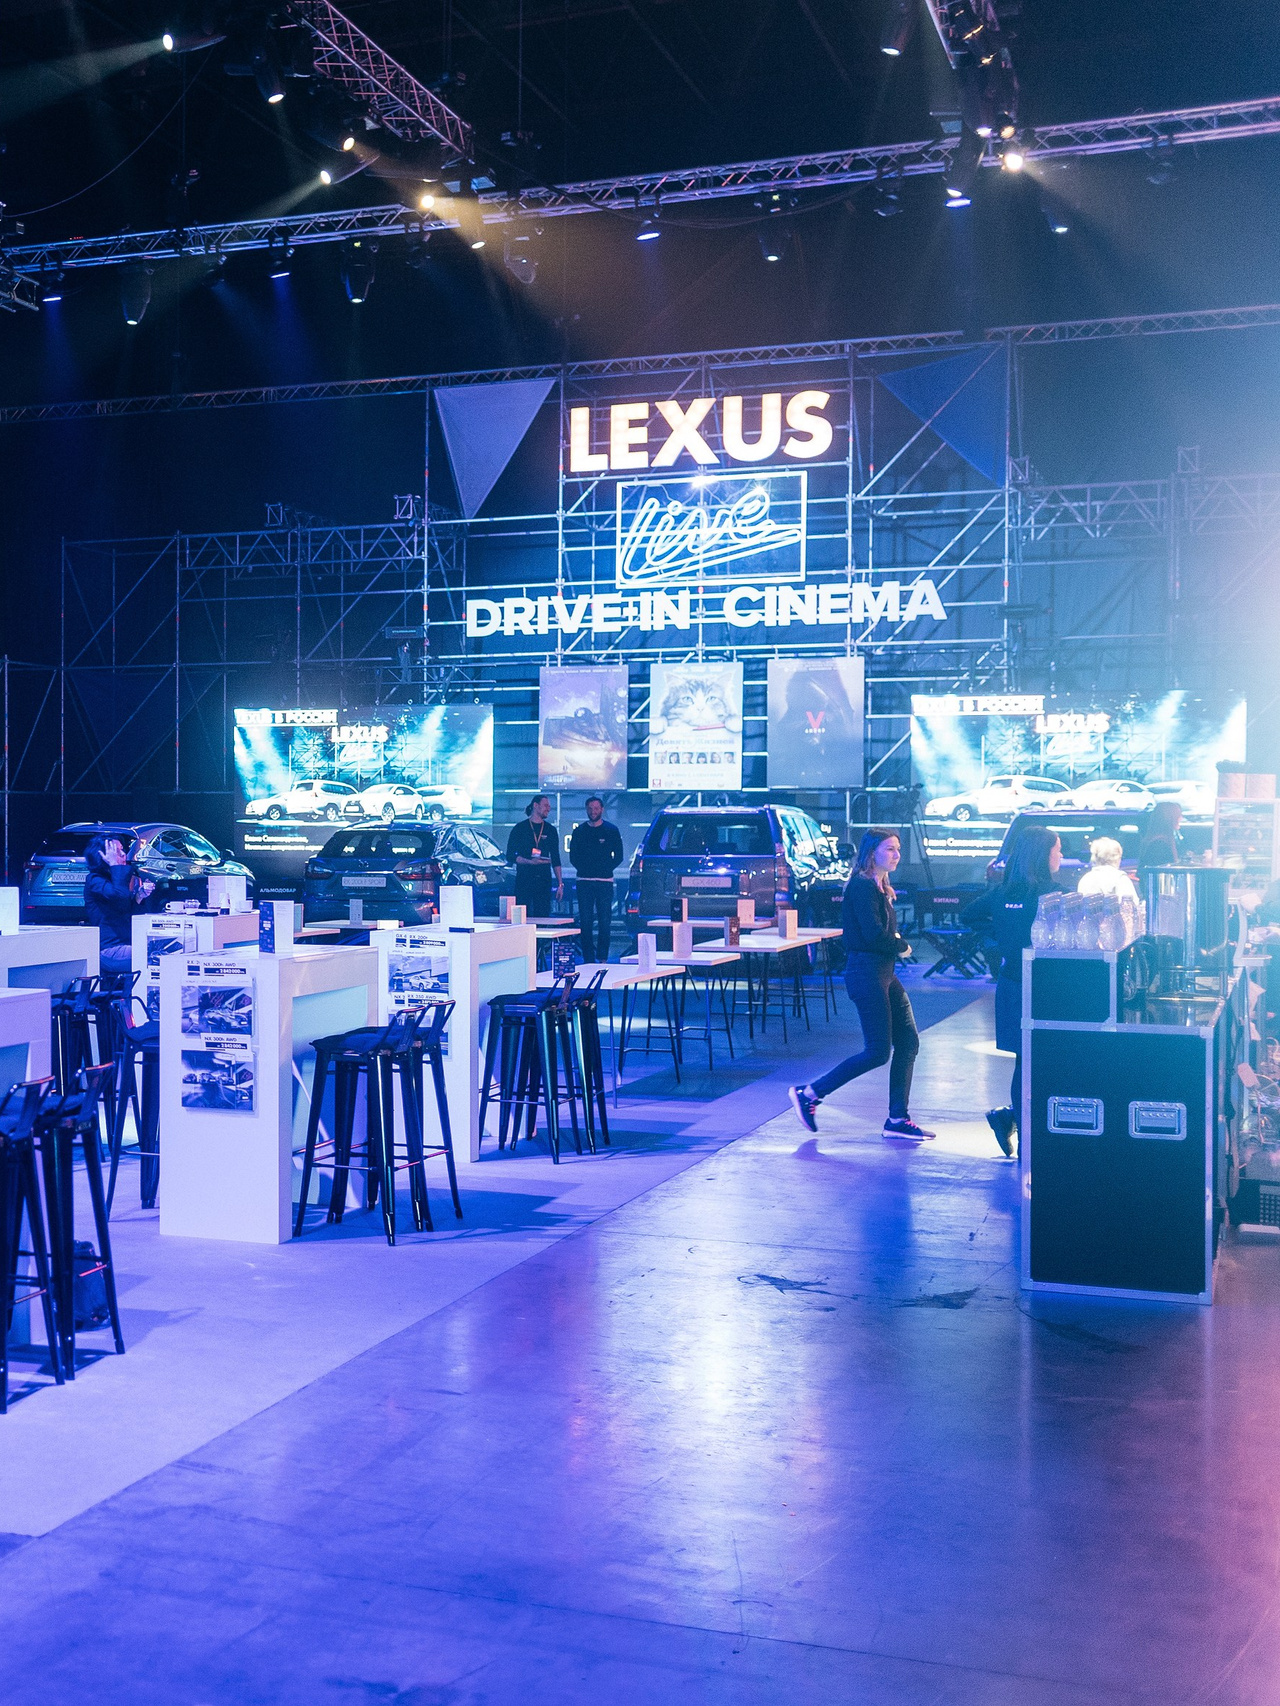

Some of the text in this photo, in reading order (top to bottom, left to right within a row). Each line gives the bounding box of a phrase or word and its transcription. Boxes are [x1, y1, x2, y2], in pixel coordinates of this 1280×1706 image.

[570, 390, 834, 473] LEXUS
[466, 579, 948, 638] DRIVE-IN CINEMA
